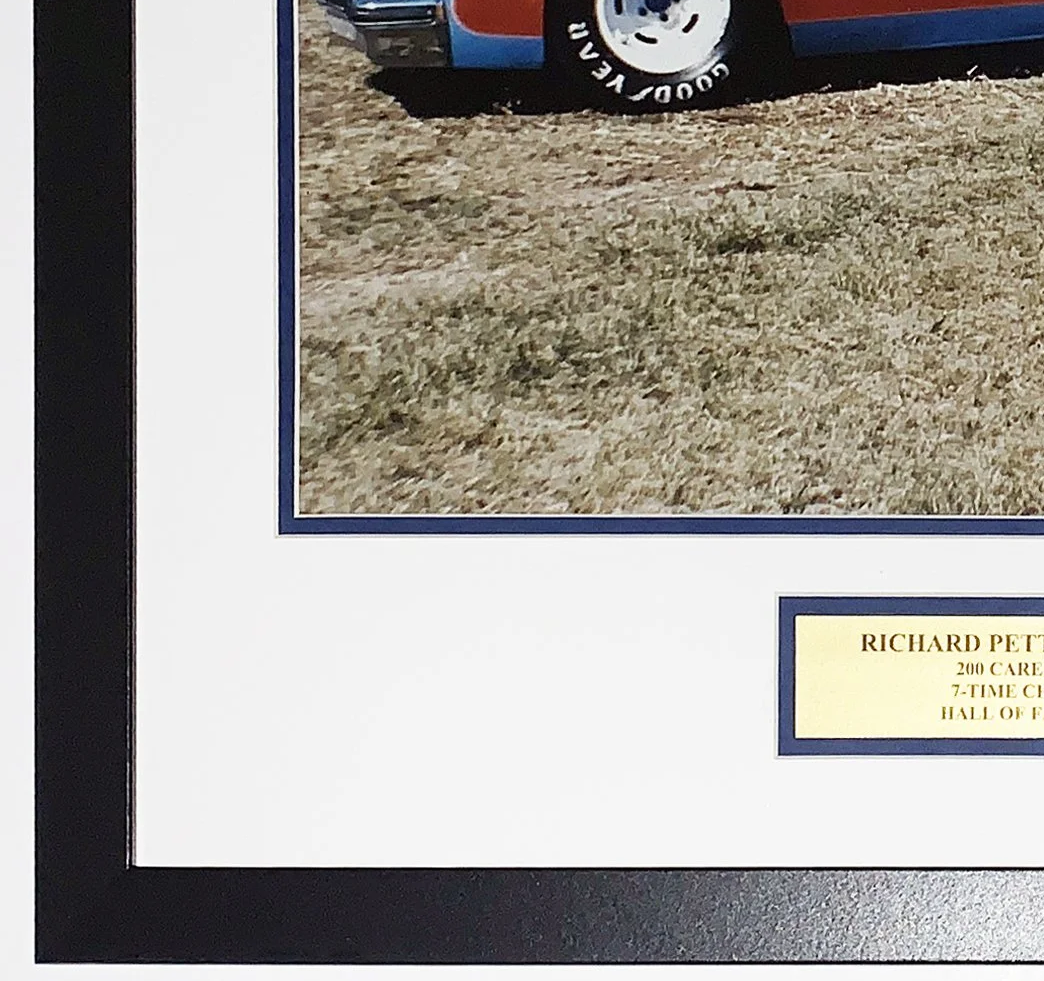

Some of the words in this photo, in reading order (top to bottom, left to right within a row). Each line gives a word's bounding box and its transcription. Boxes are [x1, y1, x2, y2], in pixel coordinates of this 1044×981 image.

[860, 633, 981, 653] RICHARD
[956, 661, 985, 676] 200
[951, 684, 1018, 698] 7-TIME
[941, 706, 995, 720] HALL
[999, 706, 1026, 720] OF
